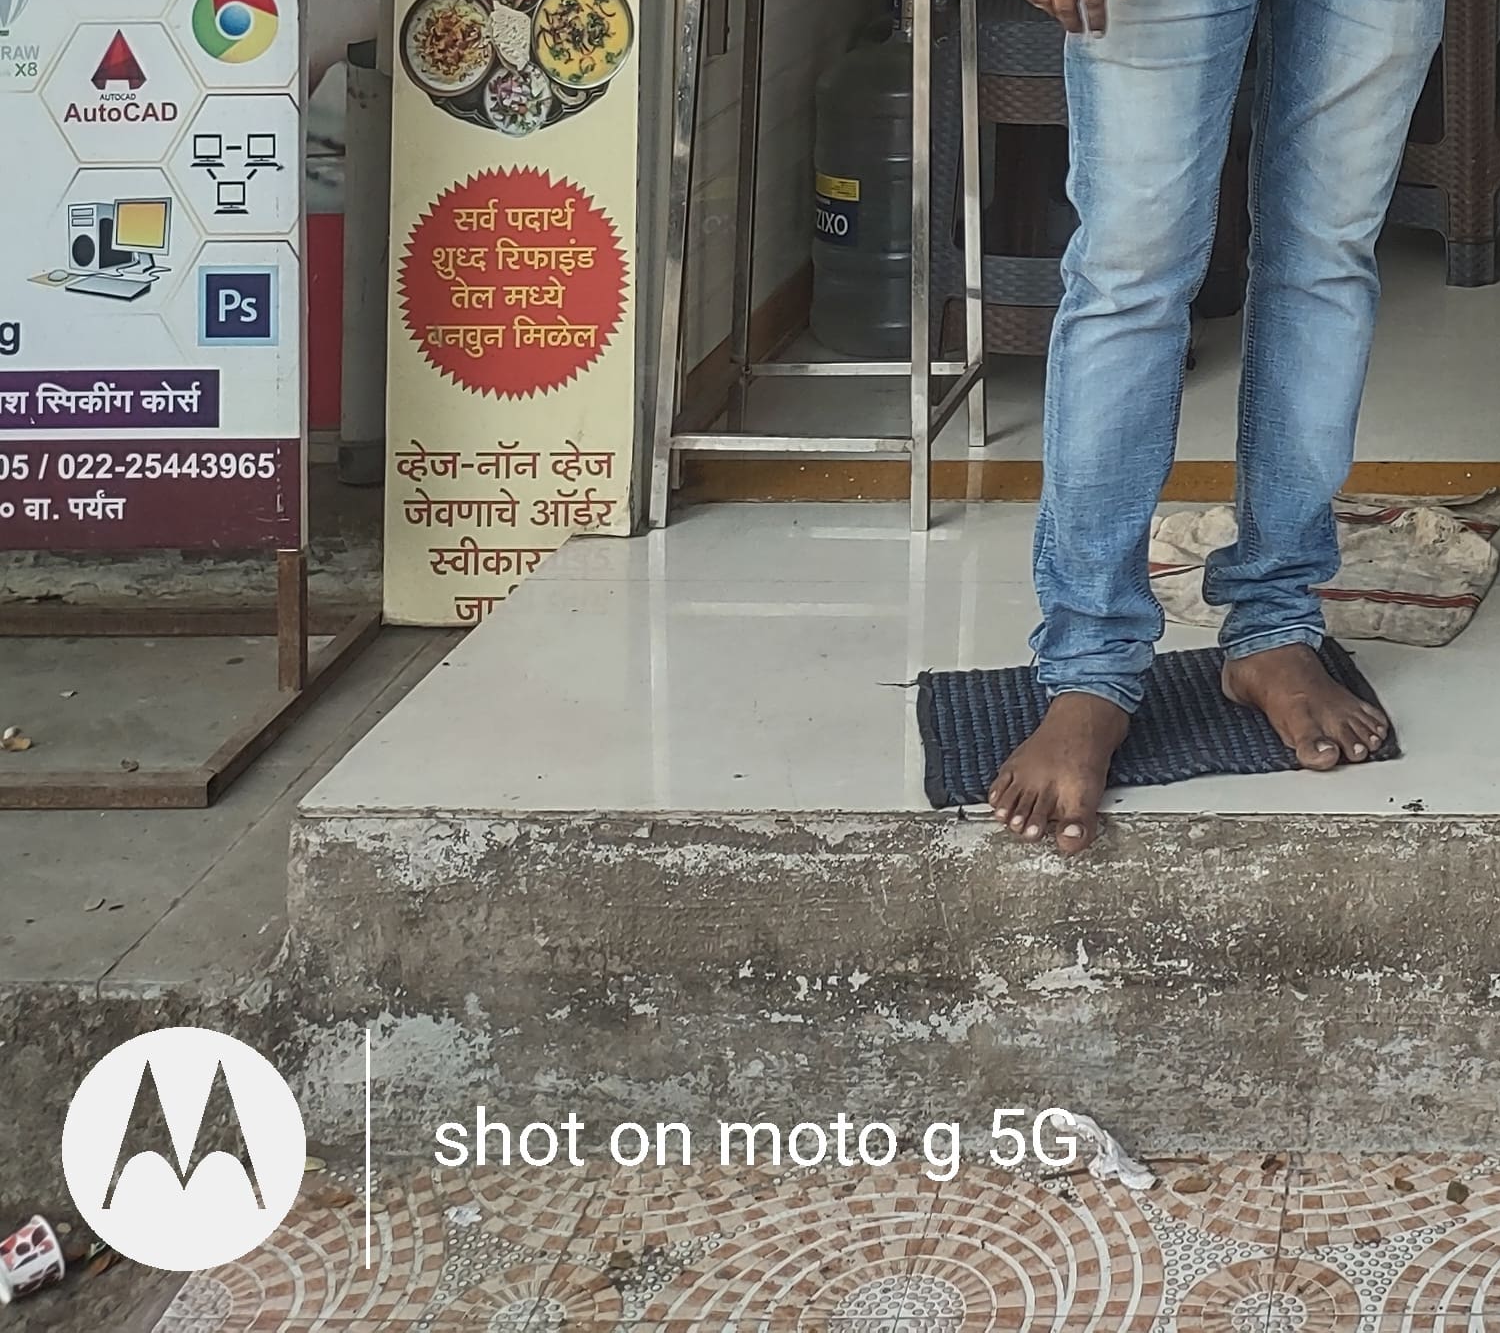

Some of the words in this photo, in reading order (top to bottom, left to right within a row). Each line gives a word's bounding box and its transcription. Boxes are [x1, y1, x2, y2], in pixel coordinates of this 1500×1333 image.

[63, 102, 178, 124] AutoCAD
[453, 197, 500, 232] सर्व
[504, 197, 577, 233] पदार्थ
[431, 246, 489, 281] शुध्द
[495, 236, 598, 278] रिफाइंड
[218, 288, 258, 324] Ps
[450, 275, 497, 310] तेल
[502, 275, 566, 310] मध्ये
[425, 323, 507, 359] बनवुन
[512, 314, 599, 349] मिळेल
[36, 381, 134, 415] स्पिकींग
[140, 380, 202, 415] कोर्स
[57, 451, 276, 481] 022-25443965
[394, 438, 541, 482] व्हेज-नॉन
[549, 438, 616, 482] व्हेज
[23, 497, 60, 521] वा.
[67, 489, 127, 521] पर्यंत
[402, 486, 520, 528] जेवणाचे
[530, 487, 618, 528] ऑर्डर
